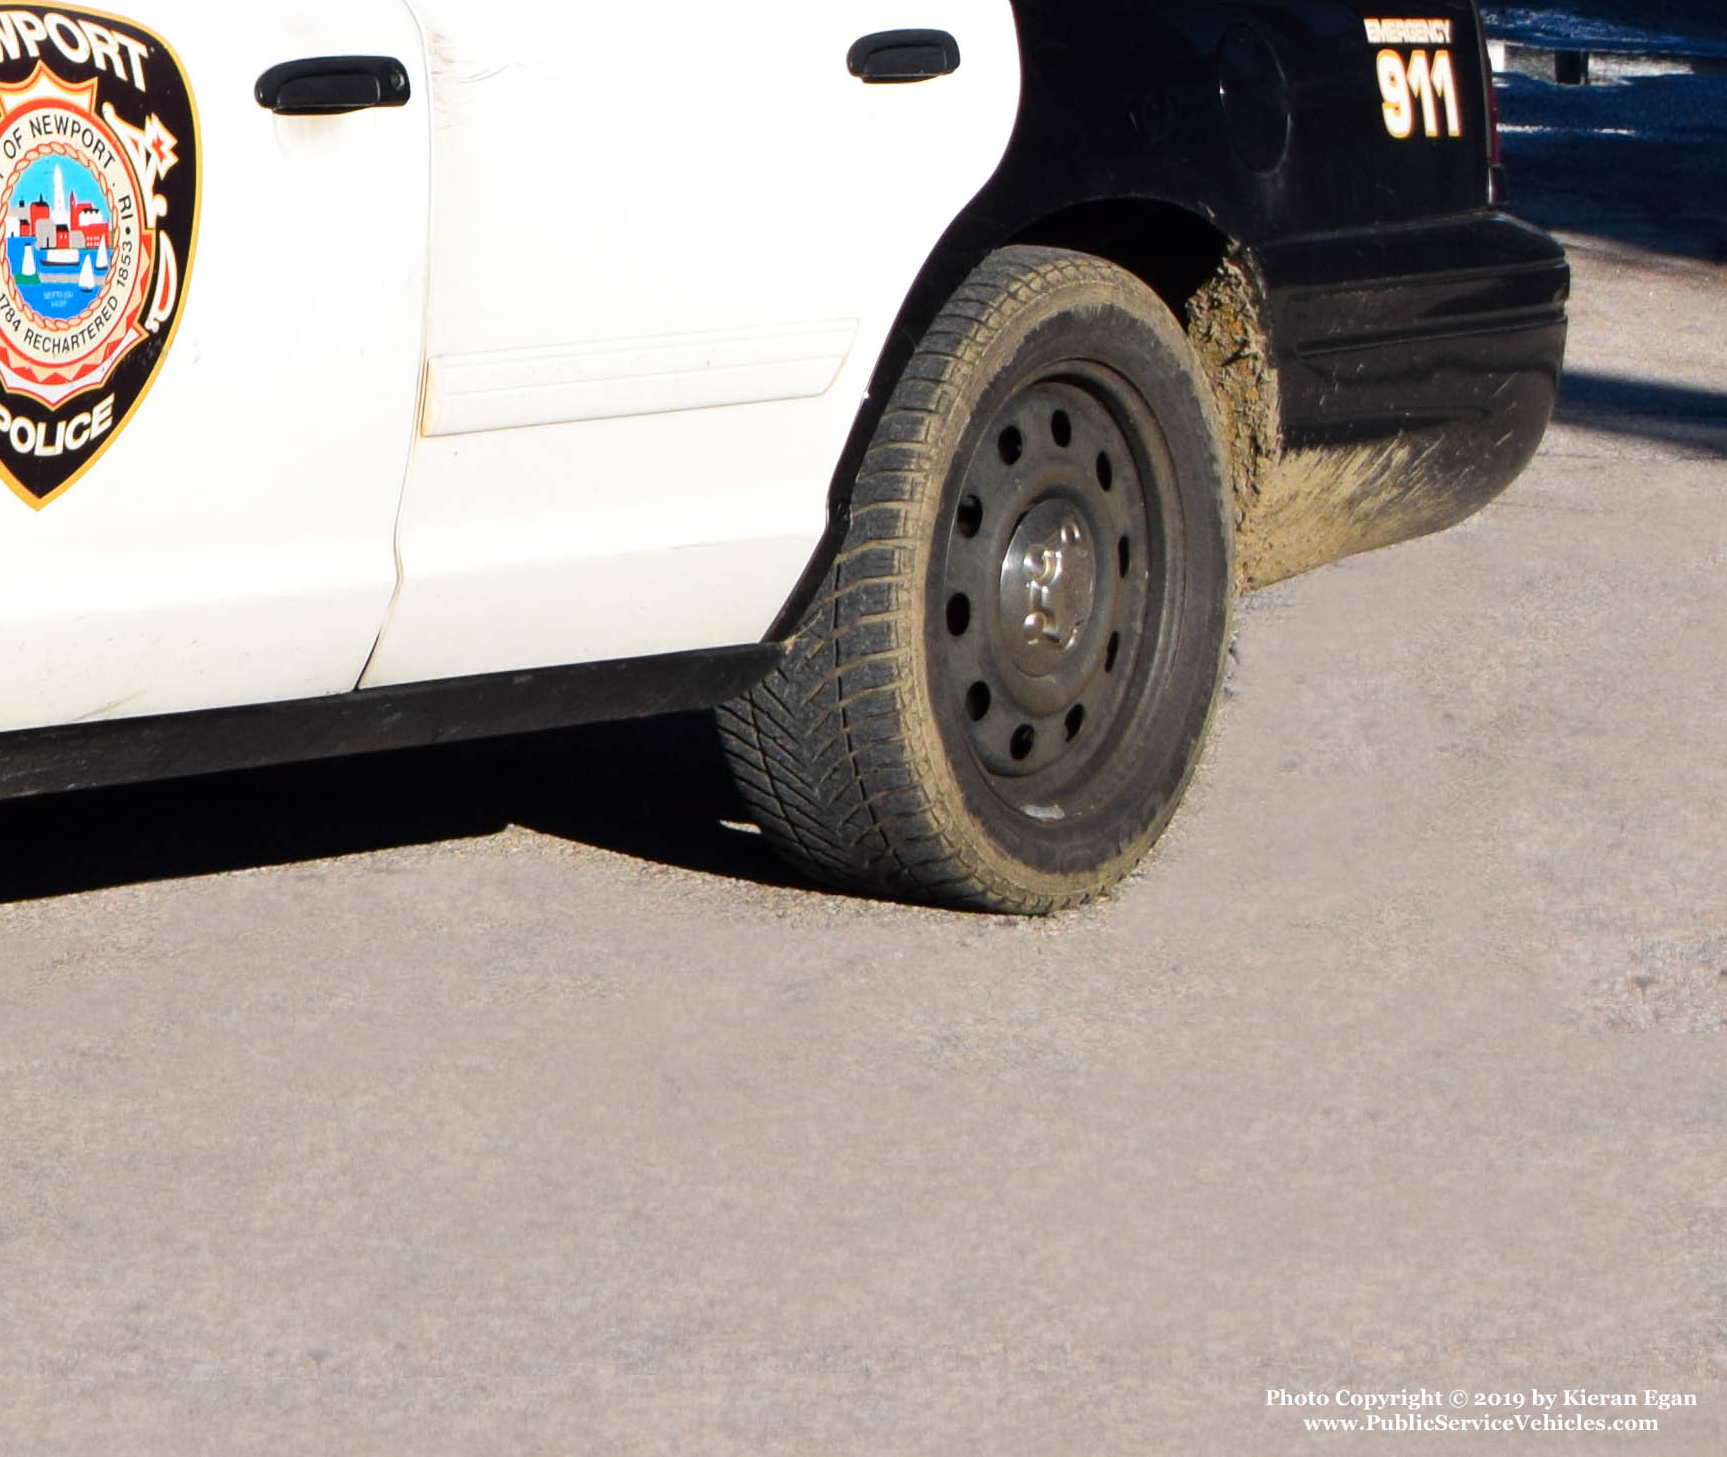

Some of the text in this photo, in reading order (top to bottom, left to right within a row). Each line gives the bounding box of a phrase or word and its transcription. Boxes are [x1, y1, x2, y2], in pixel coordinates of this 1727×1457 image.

[1376, 48, 1462, 139] 911
[3, 127, 24, 160] OF
[29, 114, 116, 169] NEWPORT
[23, 295, 119, 355] RECHARTERED
[116, 240, 133, 288] 1853
